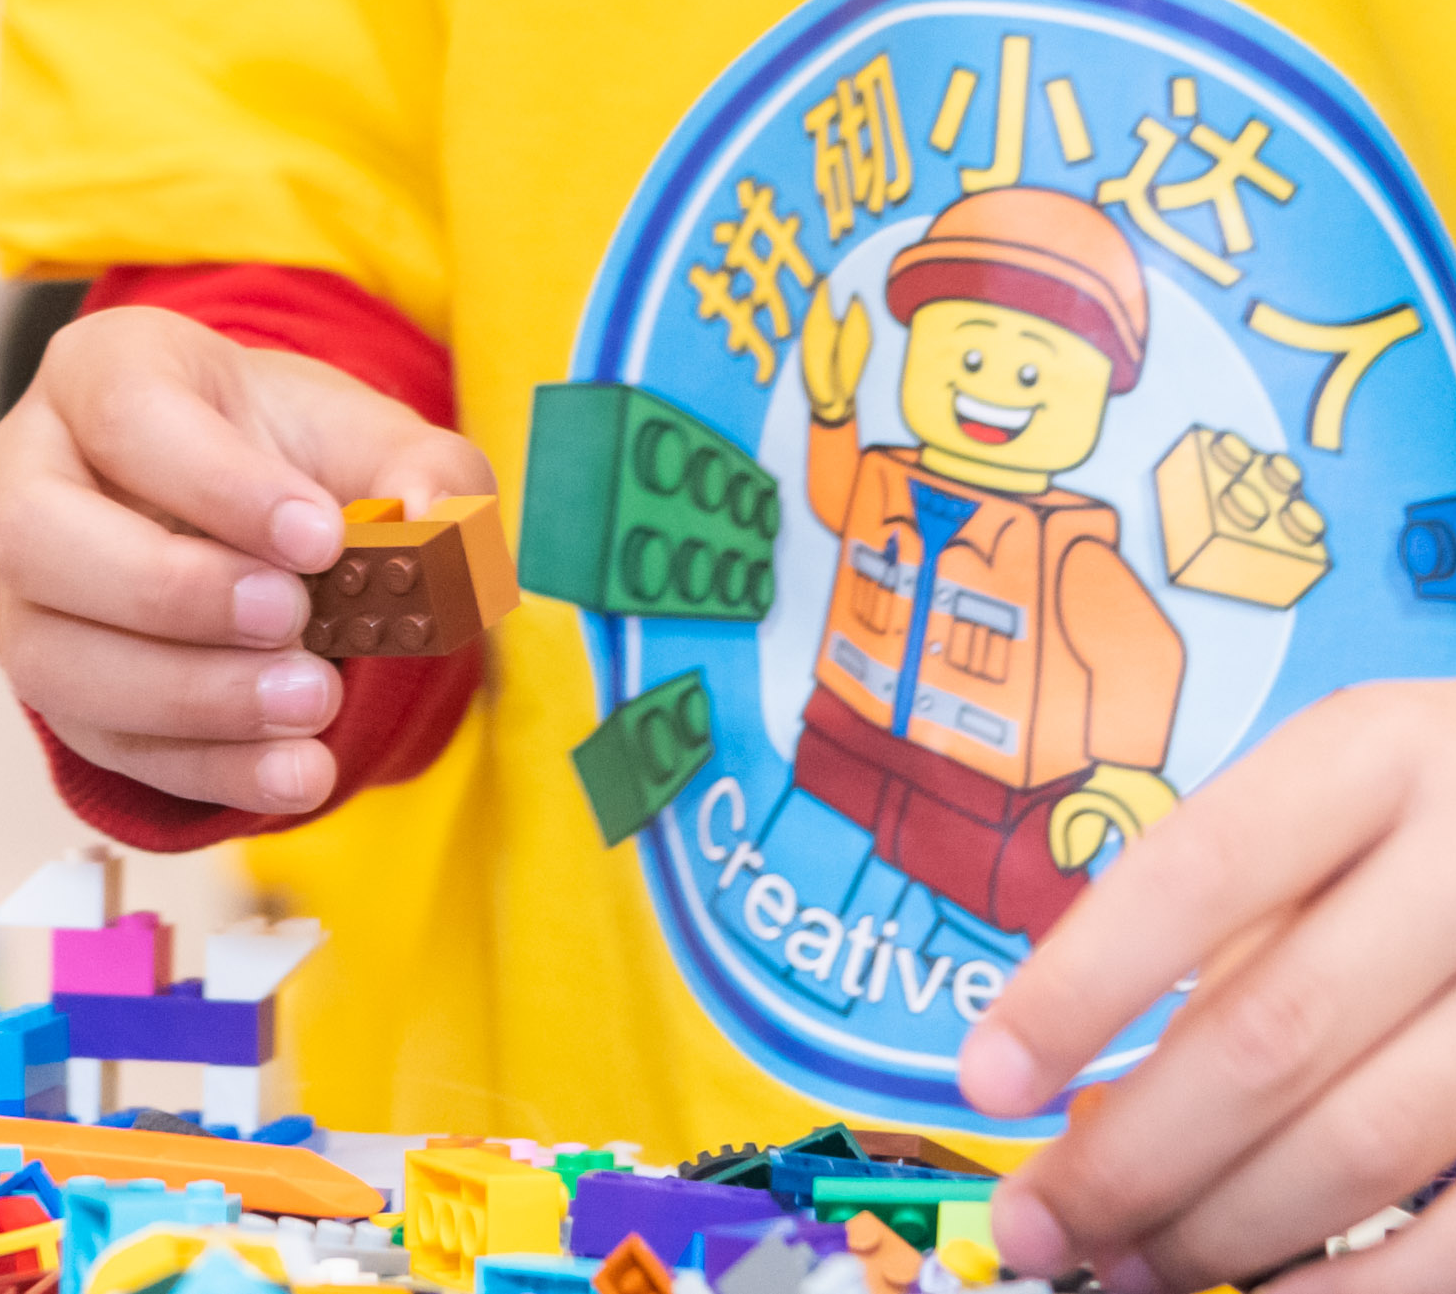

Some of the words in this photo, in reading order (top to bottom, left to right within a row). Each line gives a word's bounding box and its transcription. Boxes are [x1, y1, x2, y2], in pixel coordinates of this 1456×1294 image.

[689, 35, 1422, 452] 拼砌小达人
[697, 776, 1005, 1022] Creative
